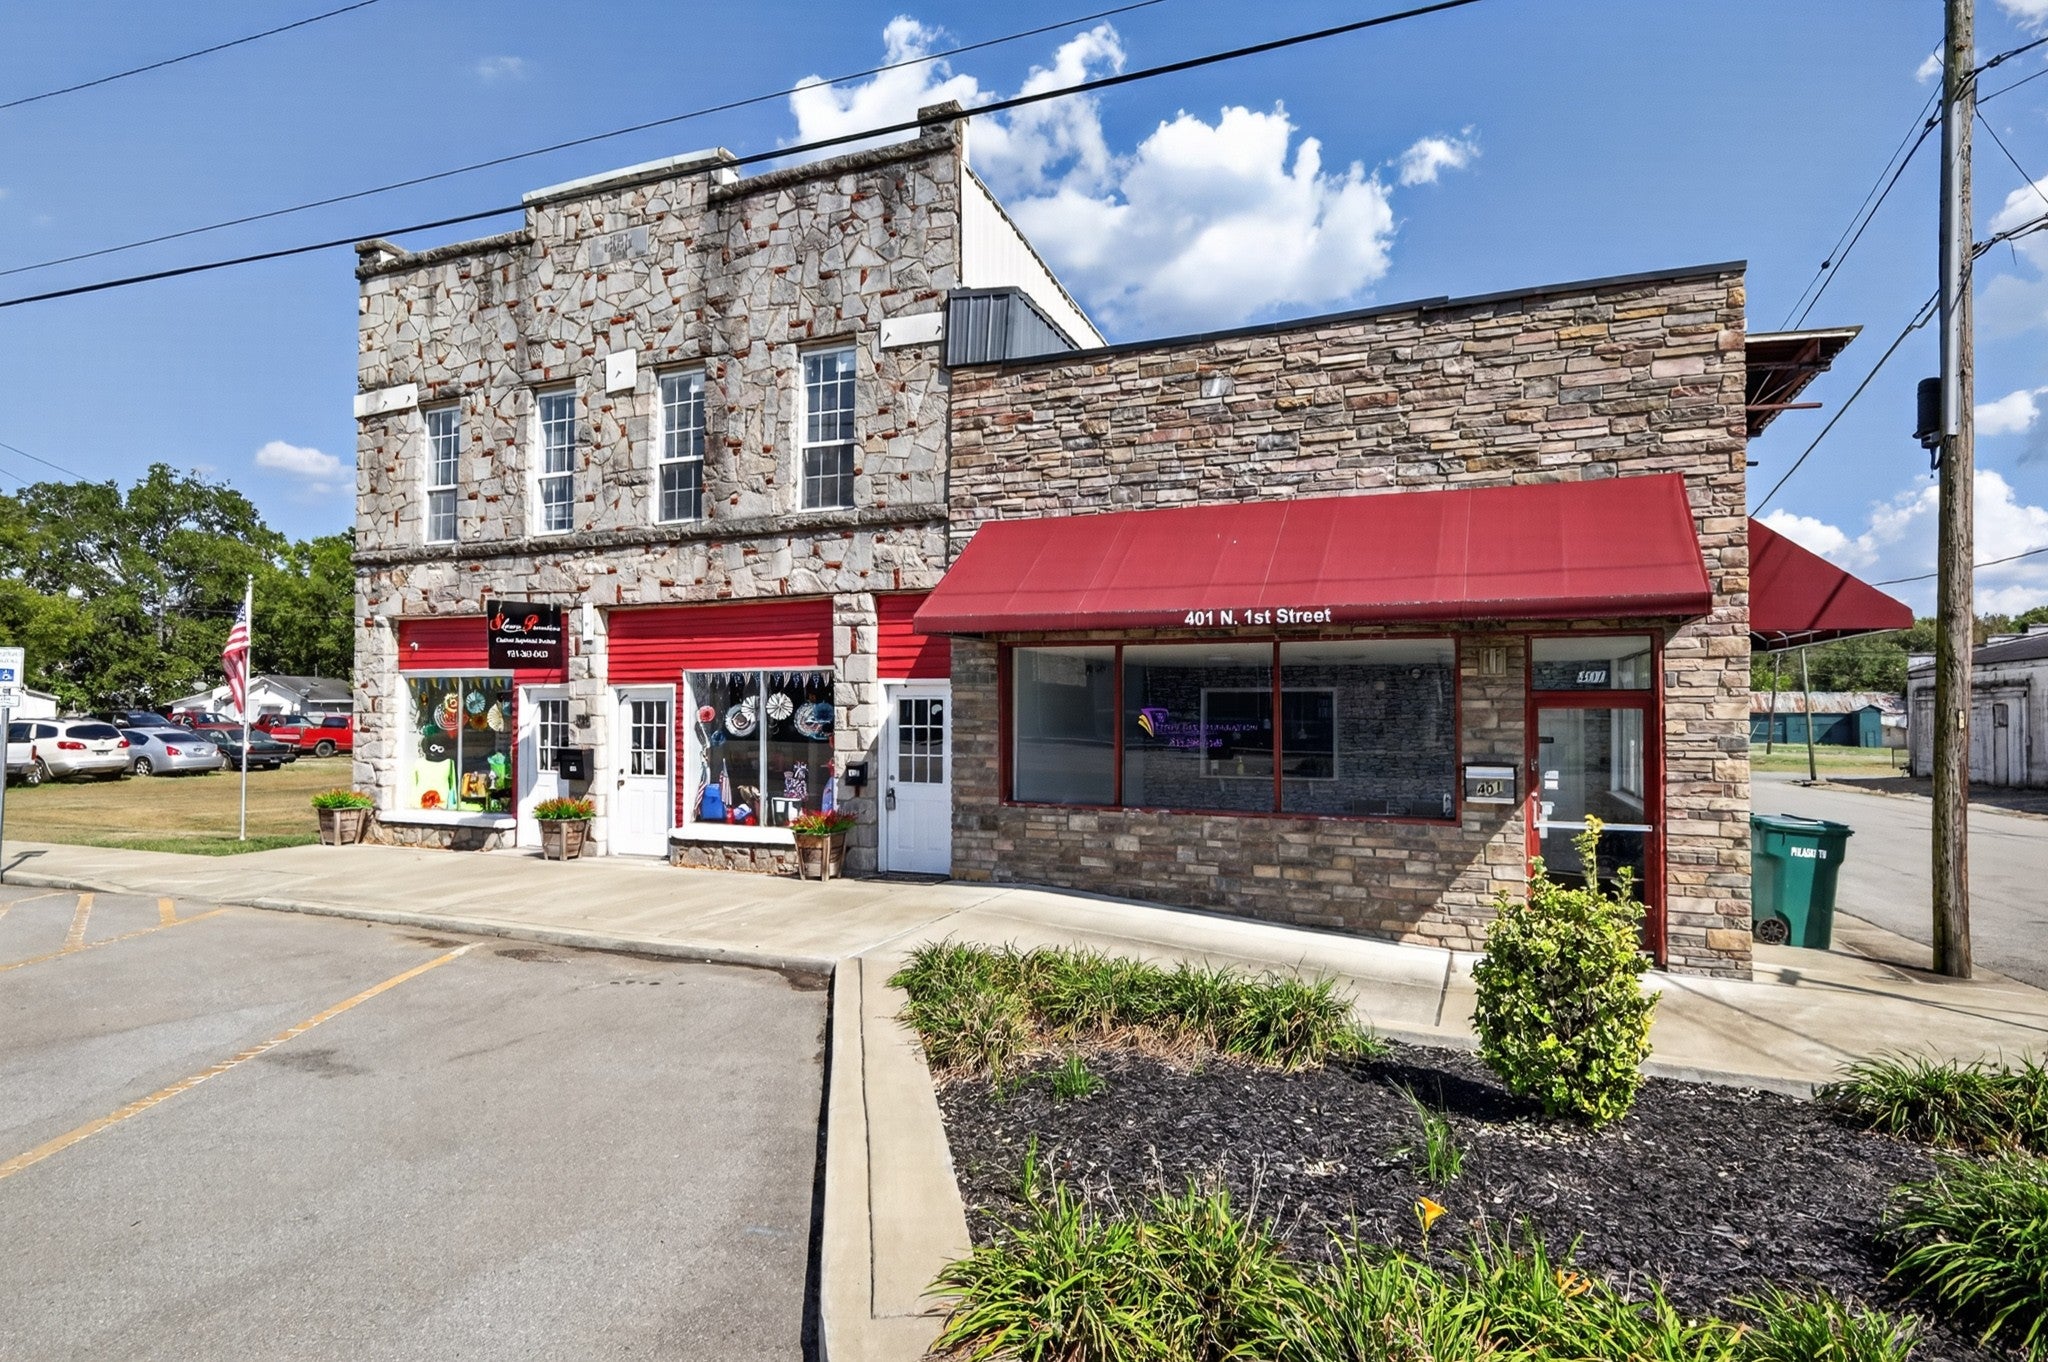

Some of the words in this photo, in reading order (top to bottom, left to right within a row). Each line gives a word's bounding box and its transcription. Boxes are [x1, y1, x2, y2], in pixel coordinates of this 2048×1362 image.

[1184, 610, 1213, 626] 401
[1220, 609, 1238, 625] N.
[1244, 609, 1271, 625] 1st
[1276, 607, 1331, 624] Street
[1477, 781, 1501, 795] 401
